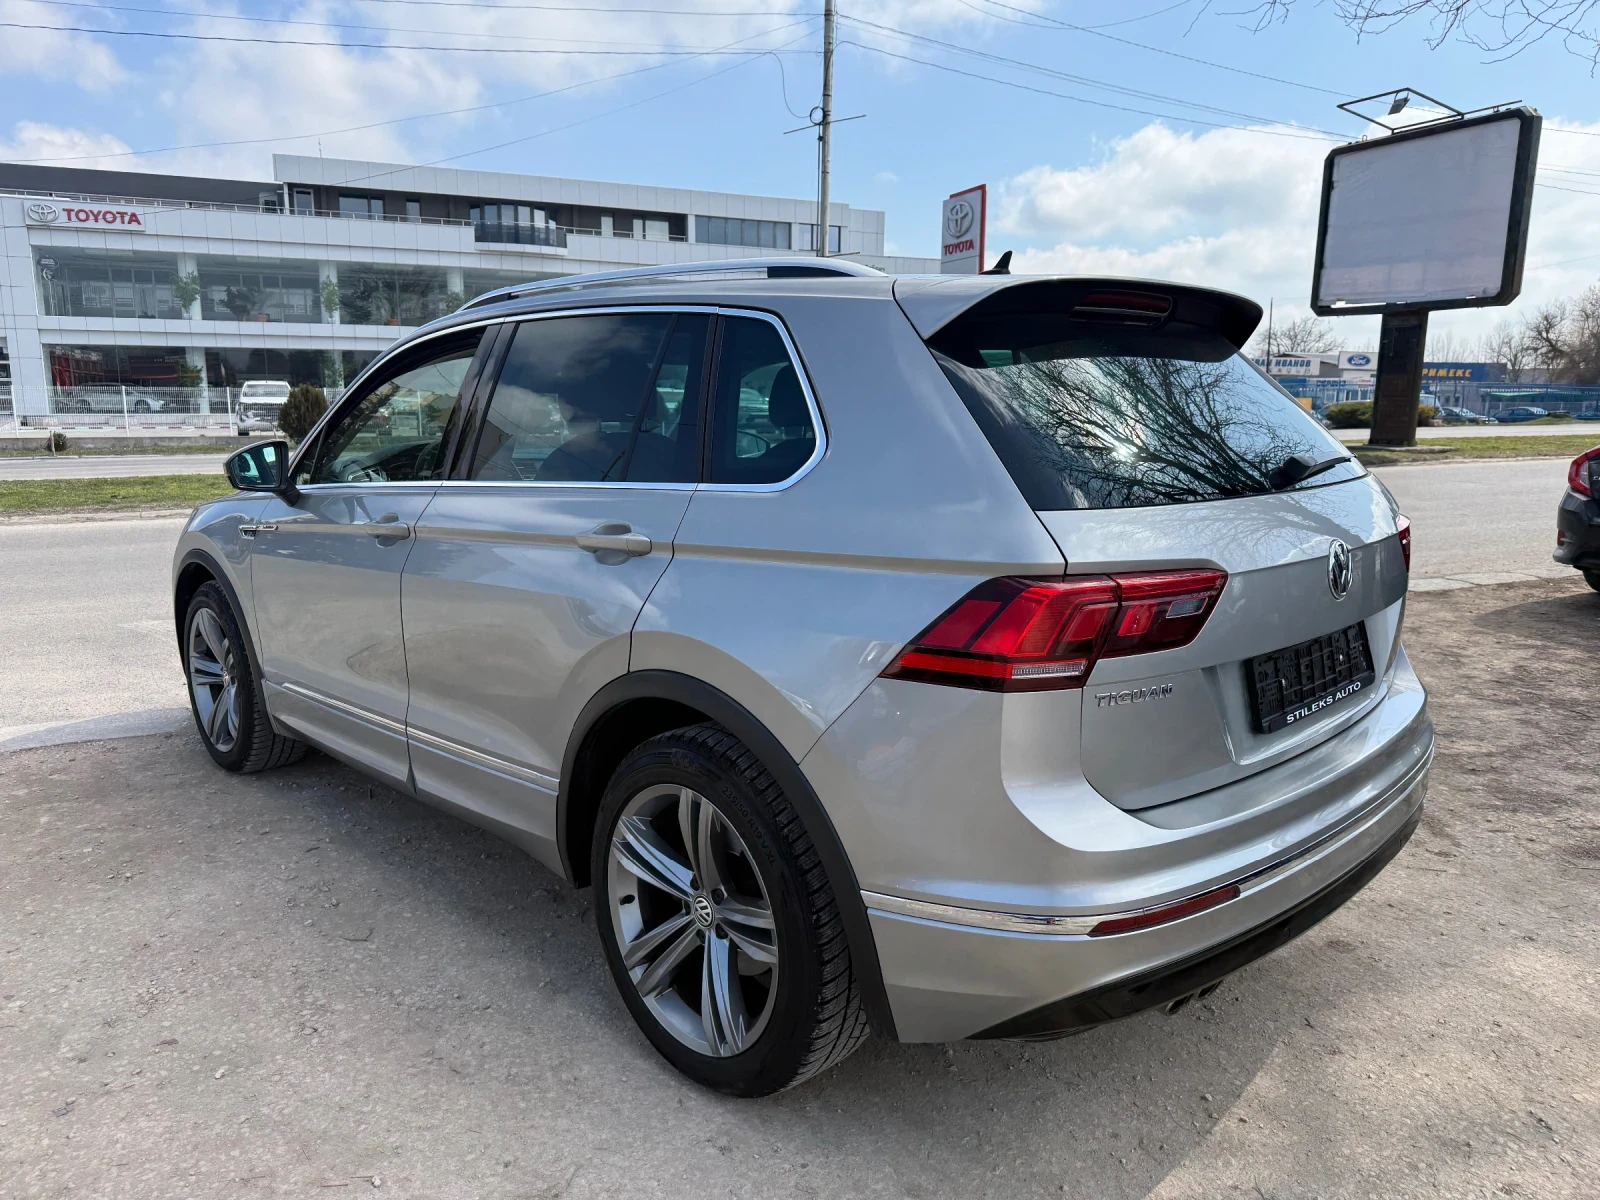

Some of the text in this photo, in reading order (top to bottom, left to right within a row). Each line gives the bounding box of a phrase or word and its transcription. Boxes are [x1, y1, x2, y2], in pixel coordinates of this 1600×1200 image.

[62, 208, 142, 226] TOYOTA
[943, 239, 974, 256] TOYOTA
[1350, 354, 1367, 365] Ford
[1421, 368, 1472, 377] РИМЕКС
[1095, 683, 1173, 707] TIGUAN
[1286, 681, 1361, 724] STILEKS AUTO
[722, 785, 749, 818] 235/50
[748, 818, 763, 838] R19
